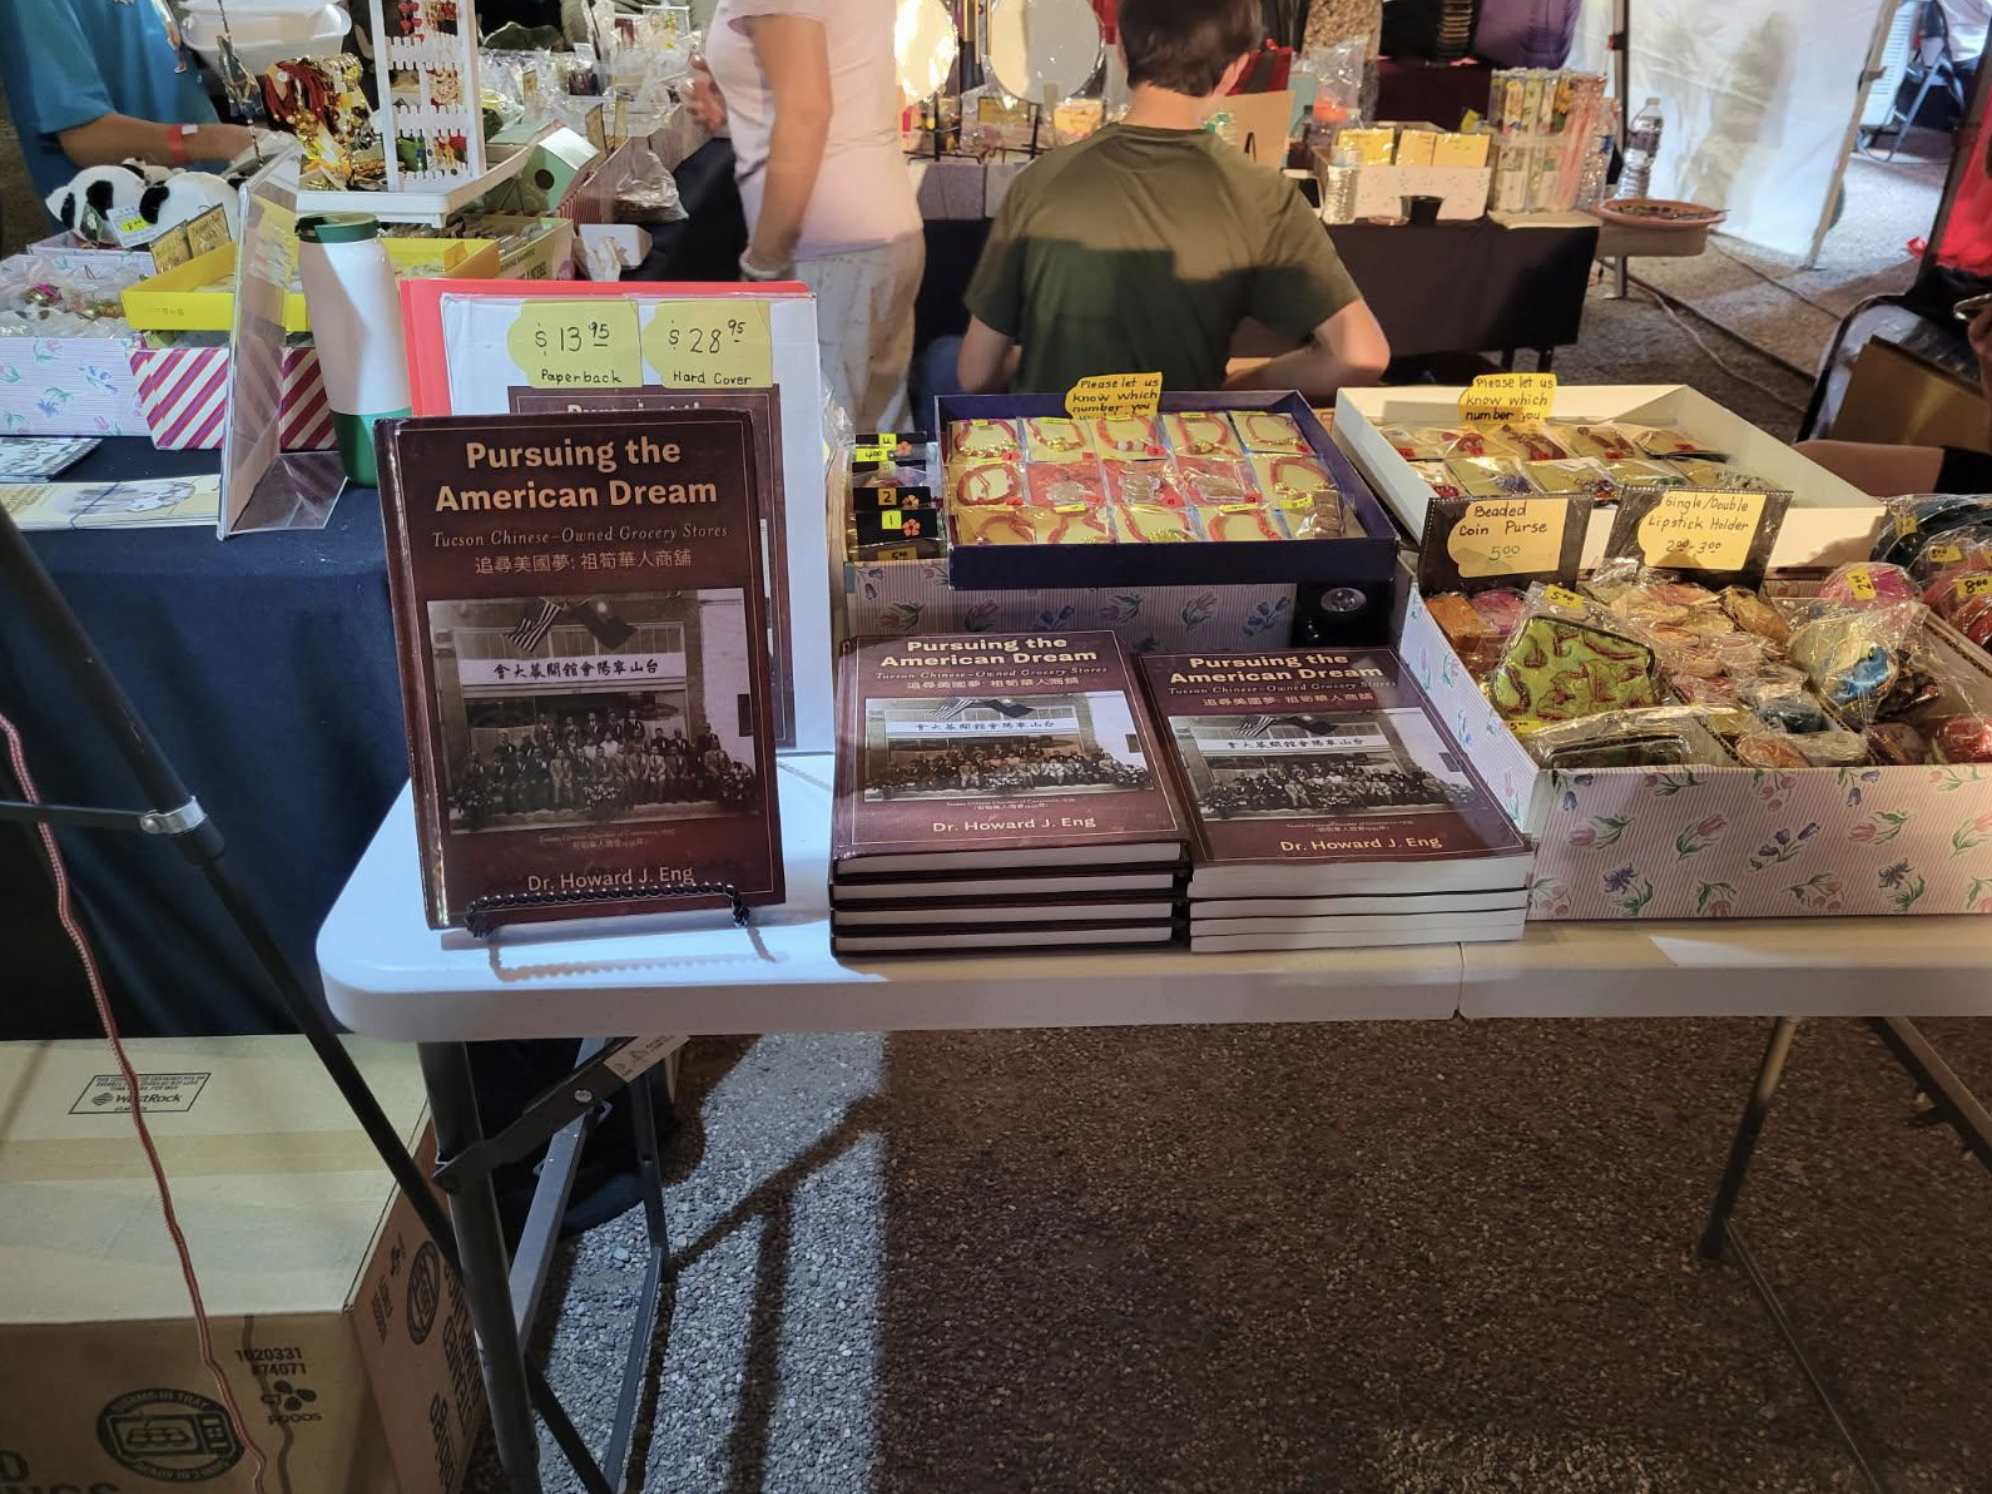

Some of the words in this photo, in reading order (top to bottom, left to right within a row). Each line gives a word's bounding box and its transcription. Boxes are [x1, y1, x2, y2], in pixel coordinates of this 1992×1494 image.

[541, 368, 622, 385] Paperback
[673, 369, 705, 384] Hard
[713, 373, 751, 386] Cover
[1080, 379, 1118, 389] Please
[1121, 376, 1137, 388] let
[1144, 379, 1159, 387] us
[1476, 378, 1514, 388] Please
[1519, 376, 1532, 388] let
[1540, 379, 1554, 388] us
[1072, 393, 1110, 403] know
[1117, 389, 1157, 400] which
[1466, 394, 1502, 406] know
[1509, 392, 1548, 407] which
[1072, 403, 1123, 413] number
[1131, 403, 1150, 414] you
[1466, 407, 1514, 420] number
[1521, 412, 1541, 423] you
[465, 438, 617, 473] Pursuing
[625, 436, 681, 464] the
[435, 480, 598, 511] American
[609, 480, 717, 506] Dream
[883, 491, 893, 503] 2
[1474, 501, 1527, 517] Beaded
[1459, 524, 1489, 536] Coin
[1505, 520, 1547, 535] Purse
[1648, 515, 1703, 532] Lipstick
[1710, 517, 1749, 531] Holder
[432, 531, 484, 547] Tucson
[619, 525, 677, 543] Grocery
[682, 523, 728, 538] Stores
[907, 639, 1020, 653] Pursuing
[1025, 637, 1067, 650] the
[880, 652, 1005, 668] American
[1013, 651, 1097, 665] Dream
[1189, 656, 1302, 669] Pursuing
[1305, 653, 1349, 665] the
[1170, 668, 1292, 684] American
[1299, 667, 1383, 680] Dream
[933, 822, 958, 832] Dr.
[965, 819, 1035, 831] Howard
[1042, 818, 1056, 828] J.
[1061, 817, 1097, 828] Eng
[1280, 841, 1307, 851] Dr.
[1311, 838, 1381, 850] Howard
[1387, 838, 1402, 848] J.
[1405, 837, 1443, 849] Eng
[528, 875, 555, 891] Dr.
[560, 868, 633, 889] Howard
[638, 868, 653, 884] J.
[659, 866, 695, 884] Eng
